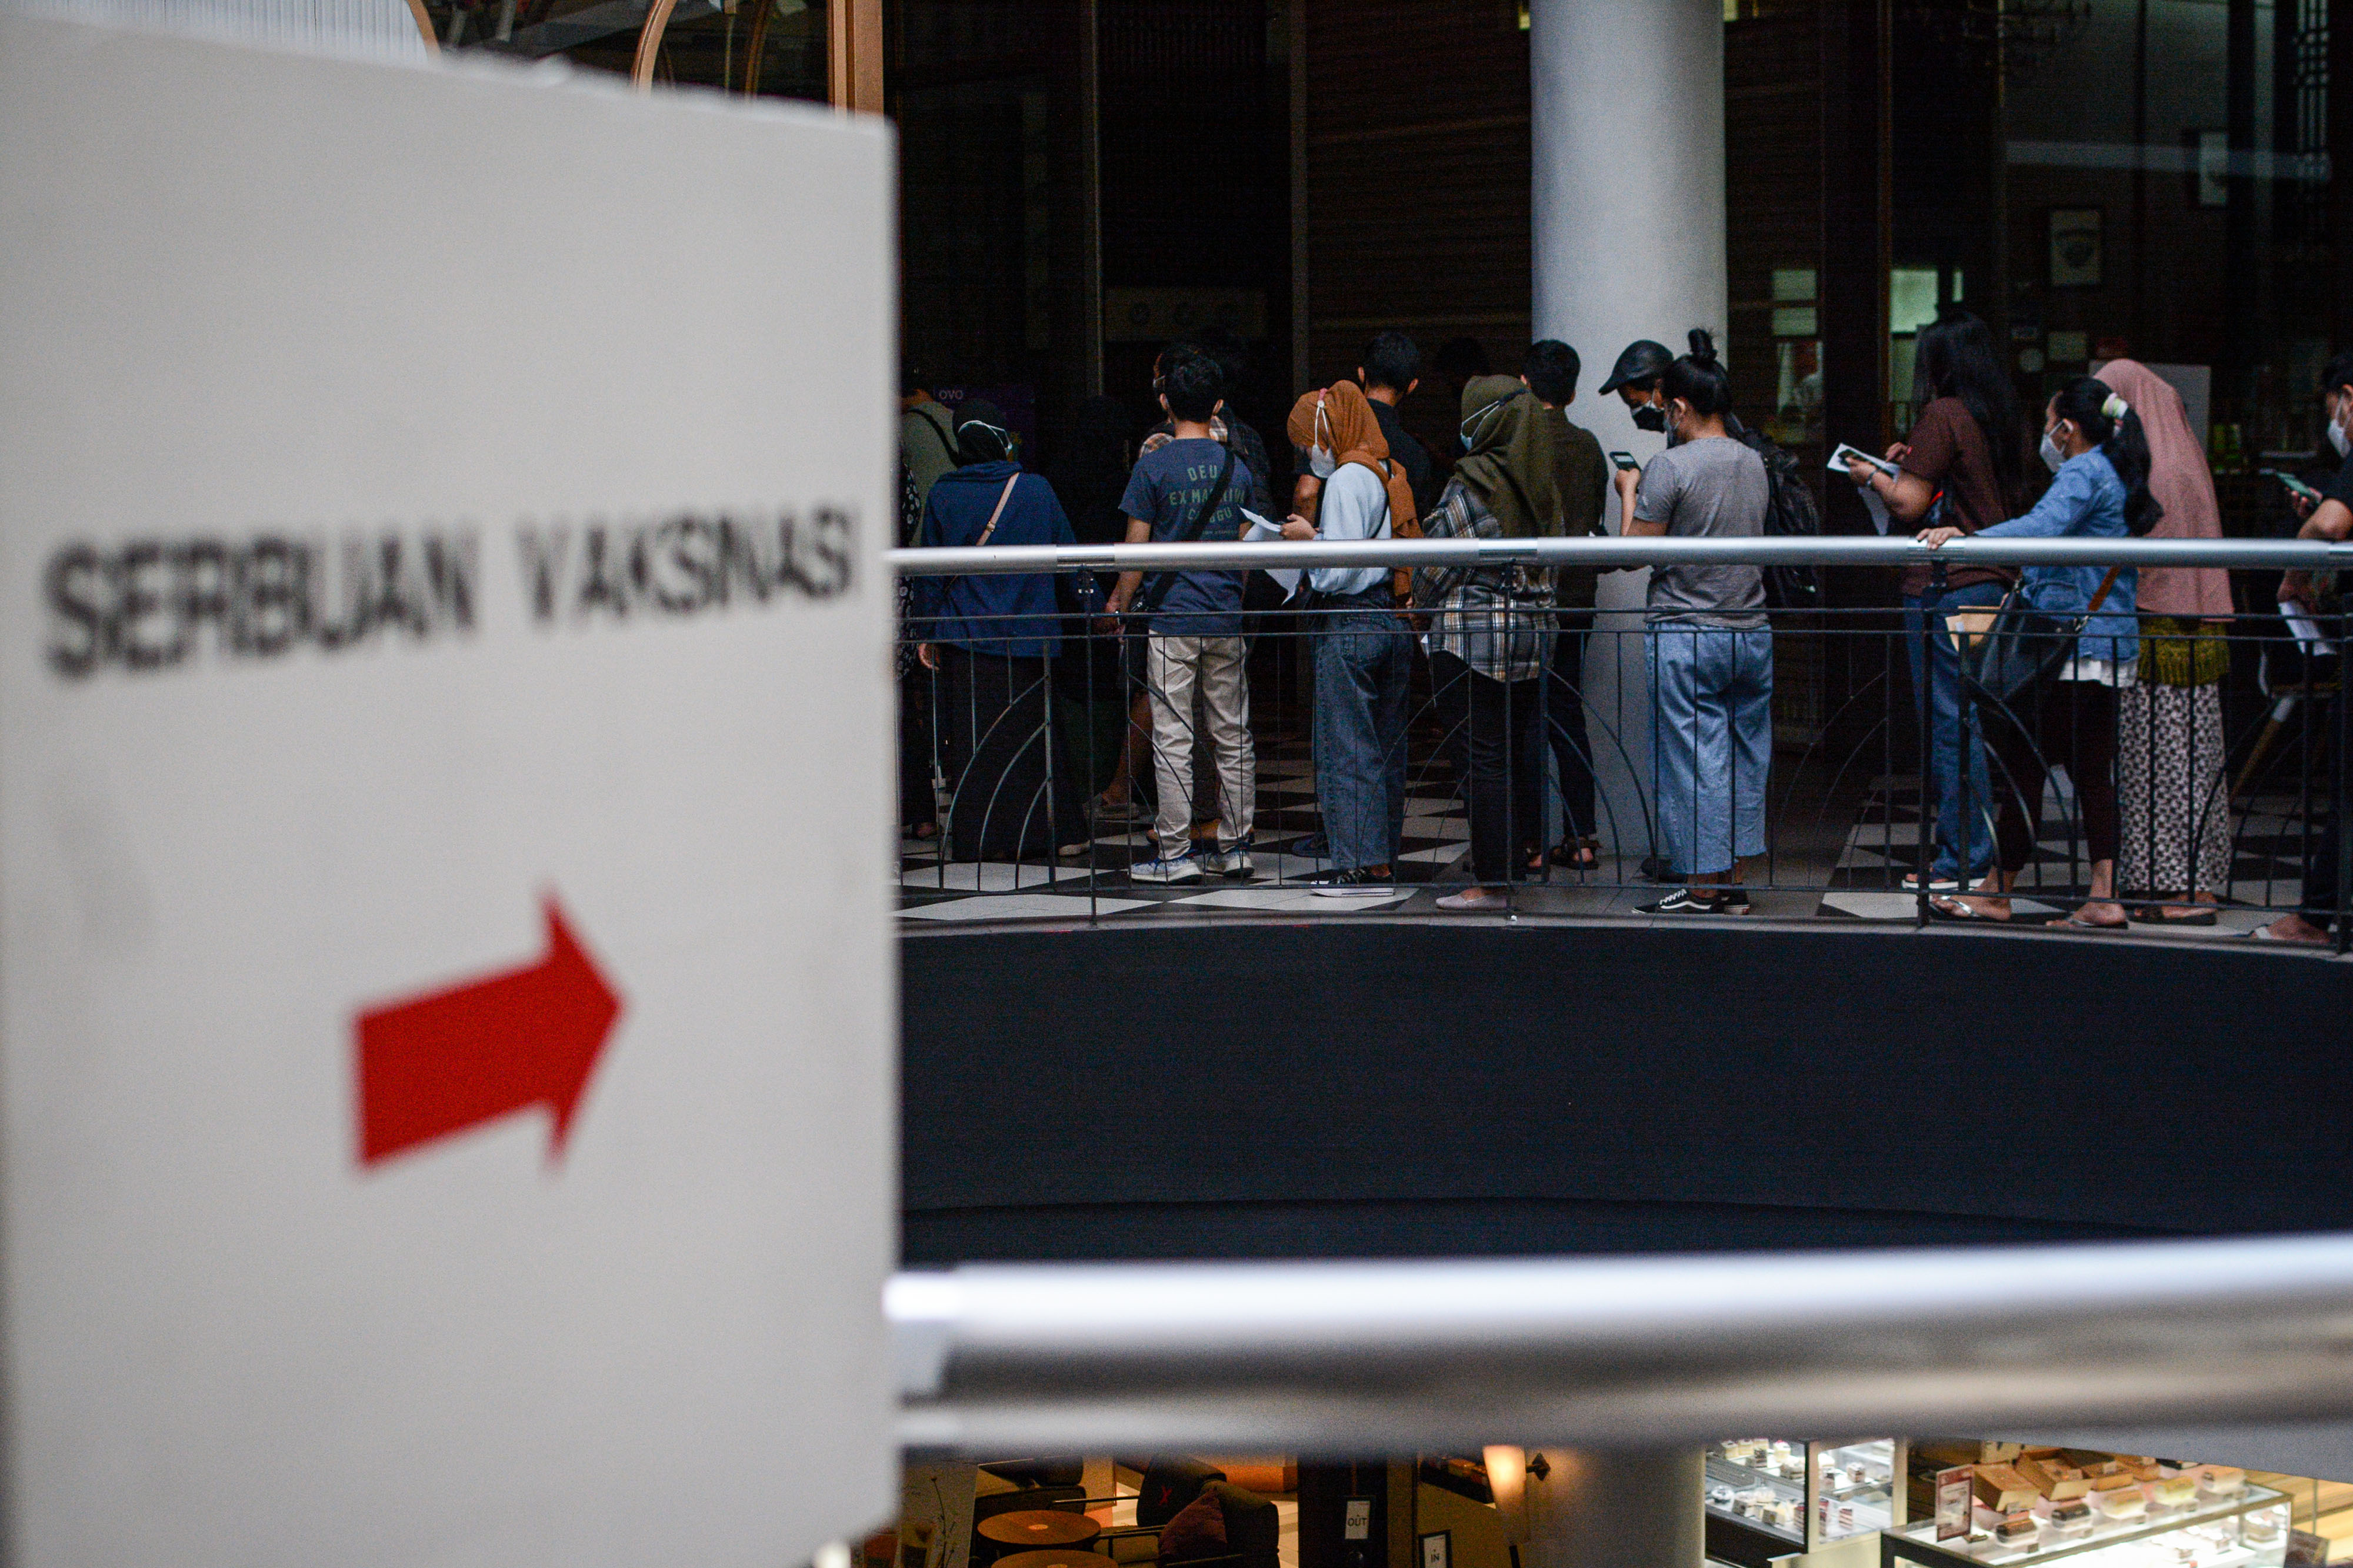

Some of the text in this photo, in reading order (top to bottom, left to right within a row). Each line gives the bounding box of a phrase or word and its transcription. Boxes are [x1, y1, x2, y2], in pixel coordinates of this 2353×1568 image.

[1187, 465, 1218, 481] DEU
[1169, 490, 1187, 506] EX
[1188, 506, 1232, 523] CGGU
[45, 523, 478, 680] SERBUAN
[1347, 1517, 1368, 1527] OUT
[1430, 1553, 1440, 1563] IN
